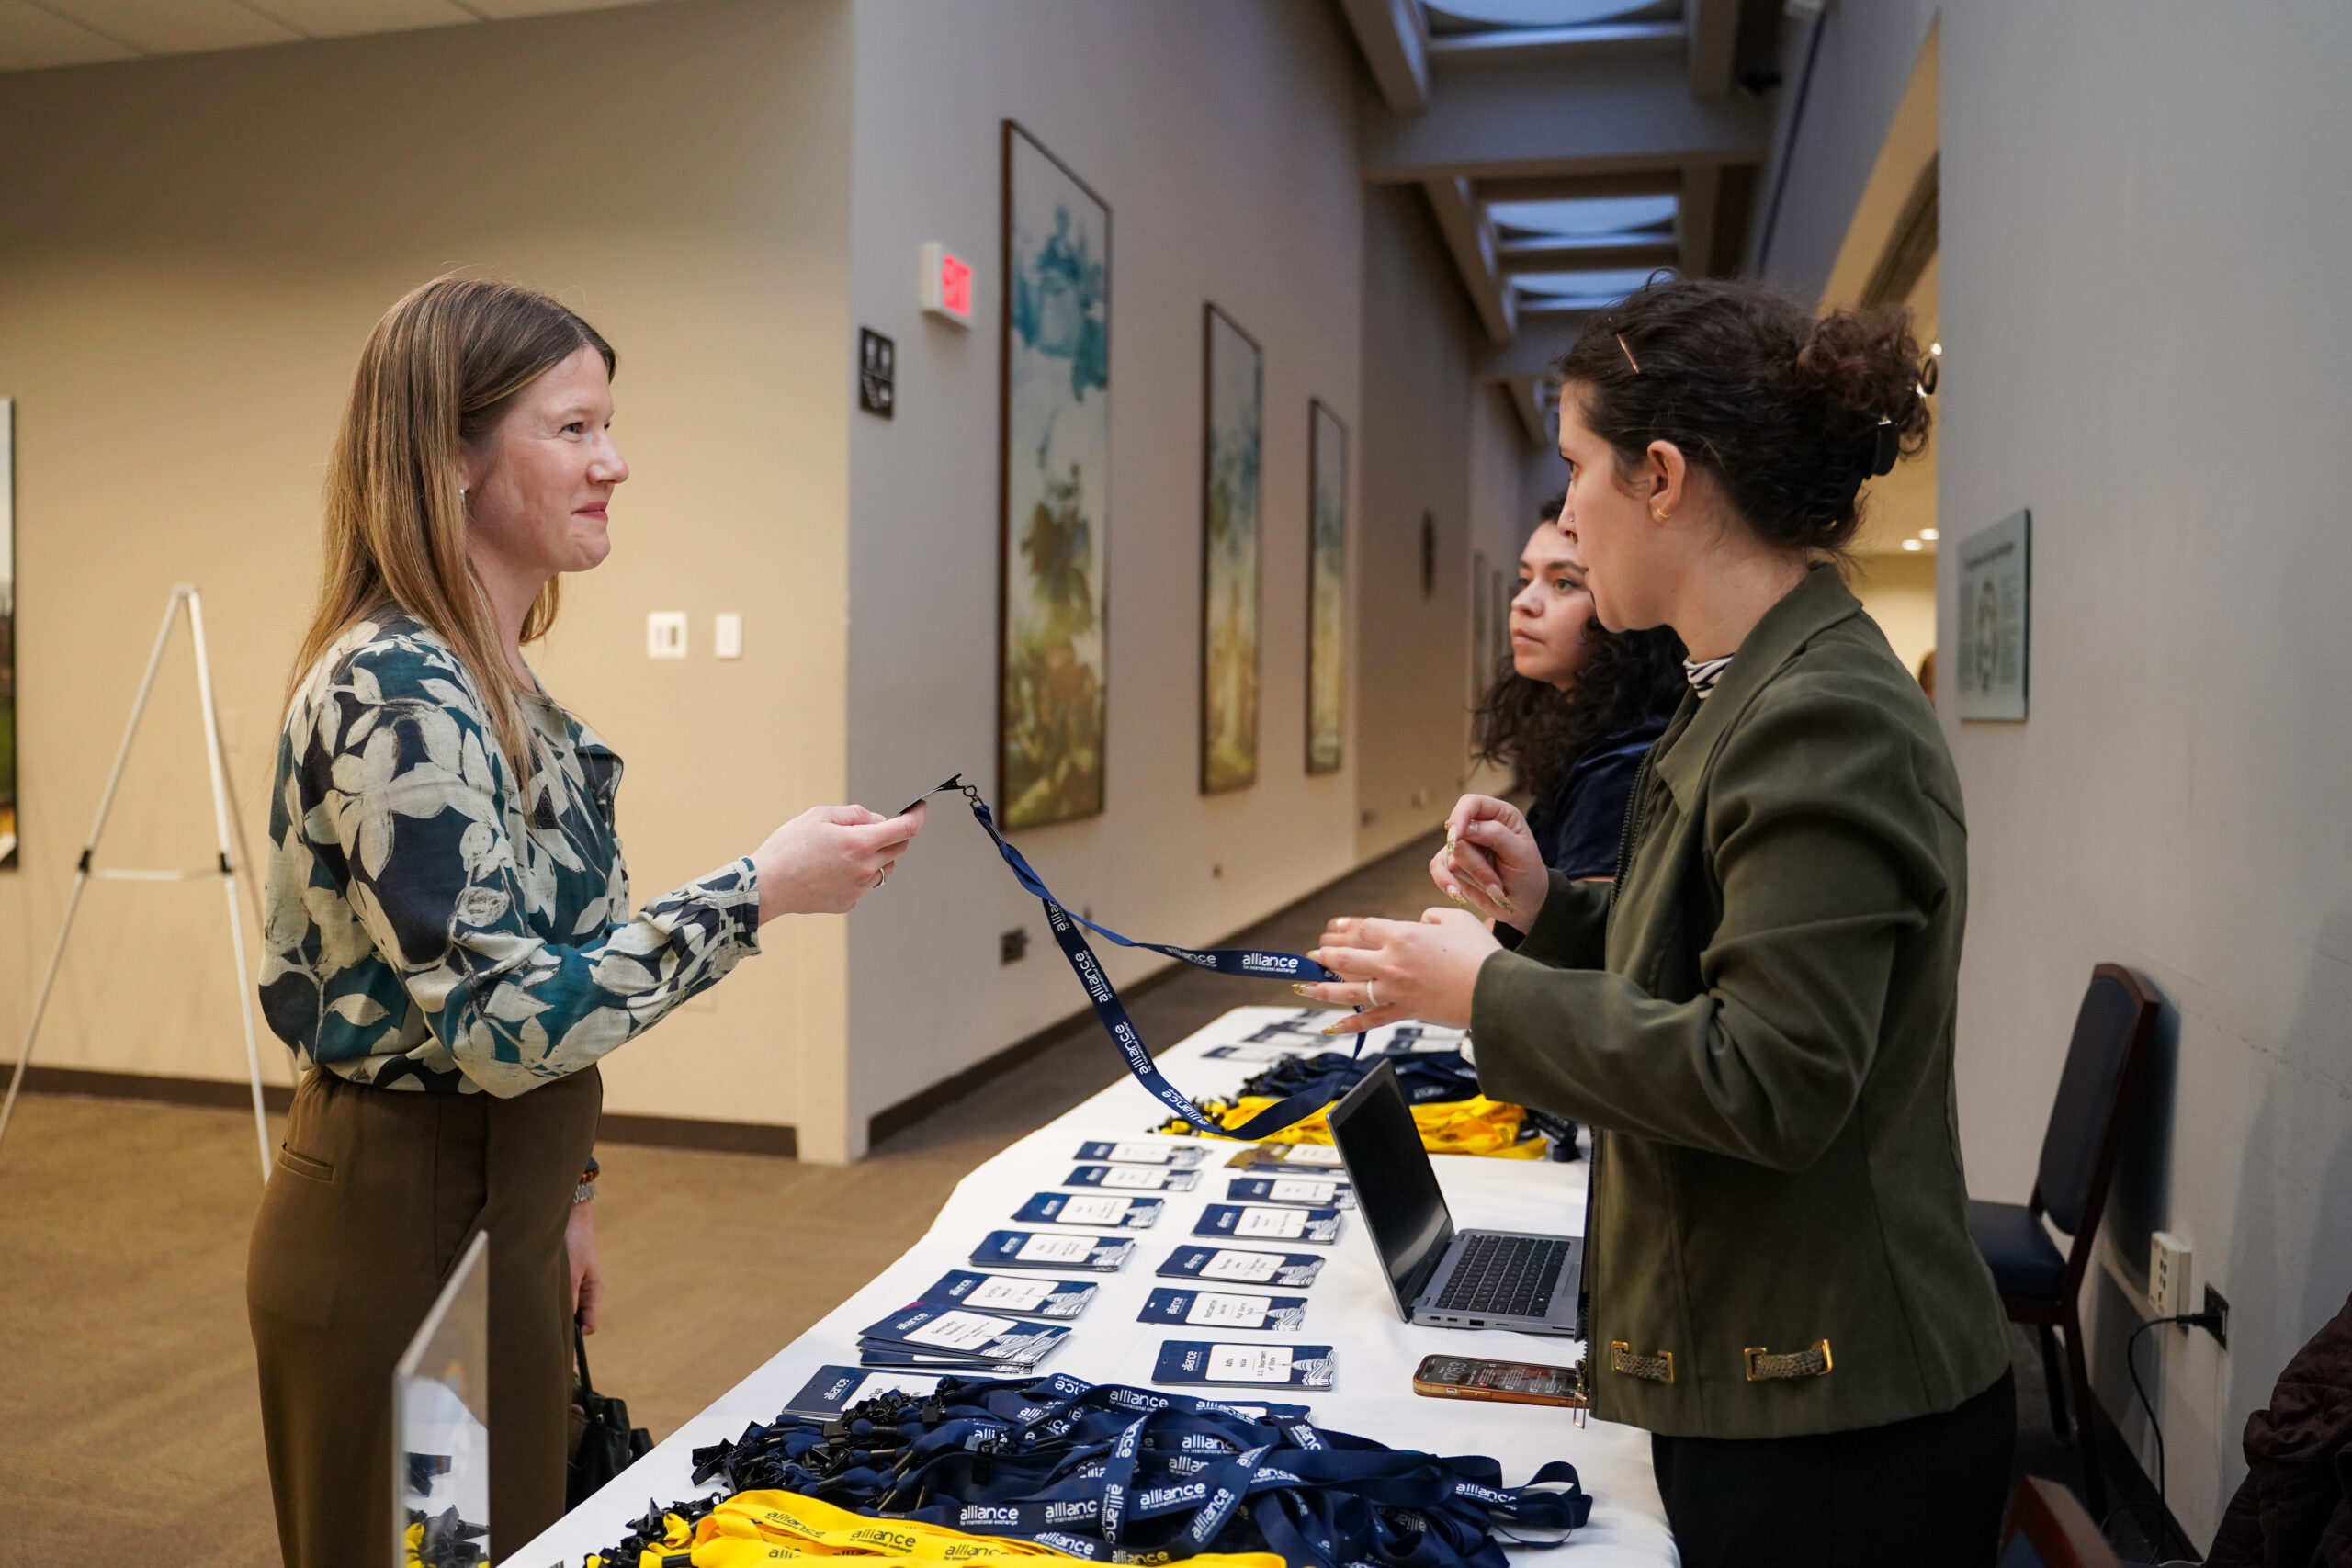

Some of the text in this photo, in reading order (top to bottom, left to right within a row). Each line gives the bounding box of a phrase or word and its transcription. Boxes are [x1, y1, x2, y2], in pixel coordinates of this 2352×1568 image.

[1165, 946, 1217, 964] alliance
[1243, 952, 1299, 968] alliance
[1075, 953, 1109, 1003] alliance
[1114, 1024, 1148, 1075] alliance
[1161, 1090, 1208, 1125] alliance
[948, 1278, 973, 1296] alliance
[1166, 1296, 1183, 1314] alliance
[896, 1312, 930, 1330] alliance
[1181, 1350, 1198, 1371] alliance
[1225, 1358, 1234, 1367] Asha
[1442, 1362, 1468, 1382] 17:53
[823, 1378, 851, 1400] alliance
[1109, 1389, 1169, 1408] alliance
[1182, 1434, 1235, 1450] allianc
[1294, 1425, 1322, 1450] allianc
[1140, 1483, 1206, 1506] alliance
[960, 1505, 1019, 1520] alliance
[1045, 1500, 1098, 1518] allianc
[1105, 1483, 1125, 1544] allianc
[1191, 1488, 1229, 1540] alliance
[851, 1529, 916, 1547] alliance
[1035, 1531, 1095, 1555] alliance
[1112, 1550, 1170, 1564] alliance
